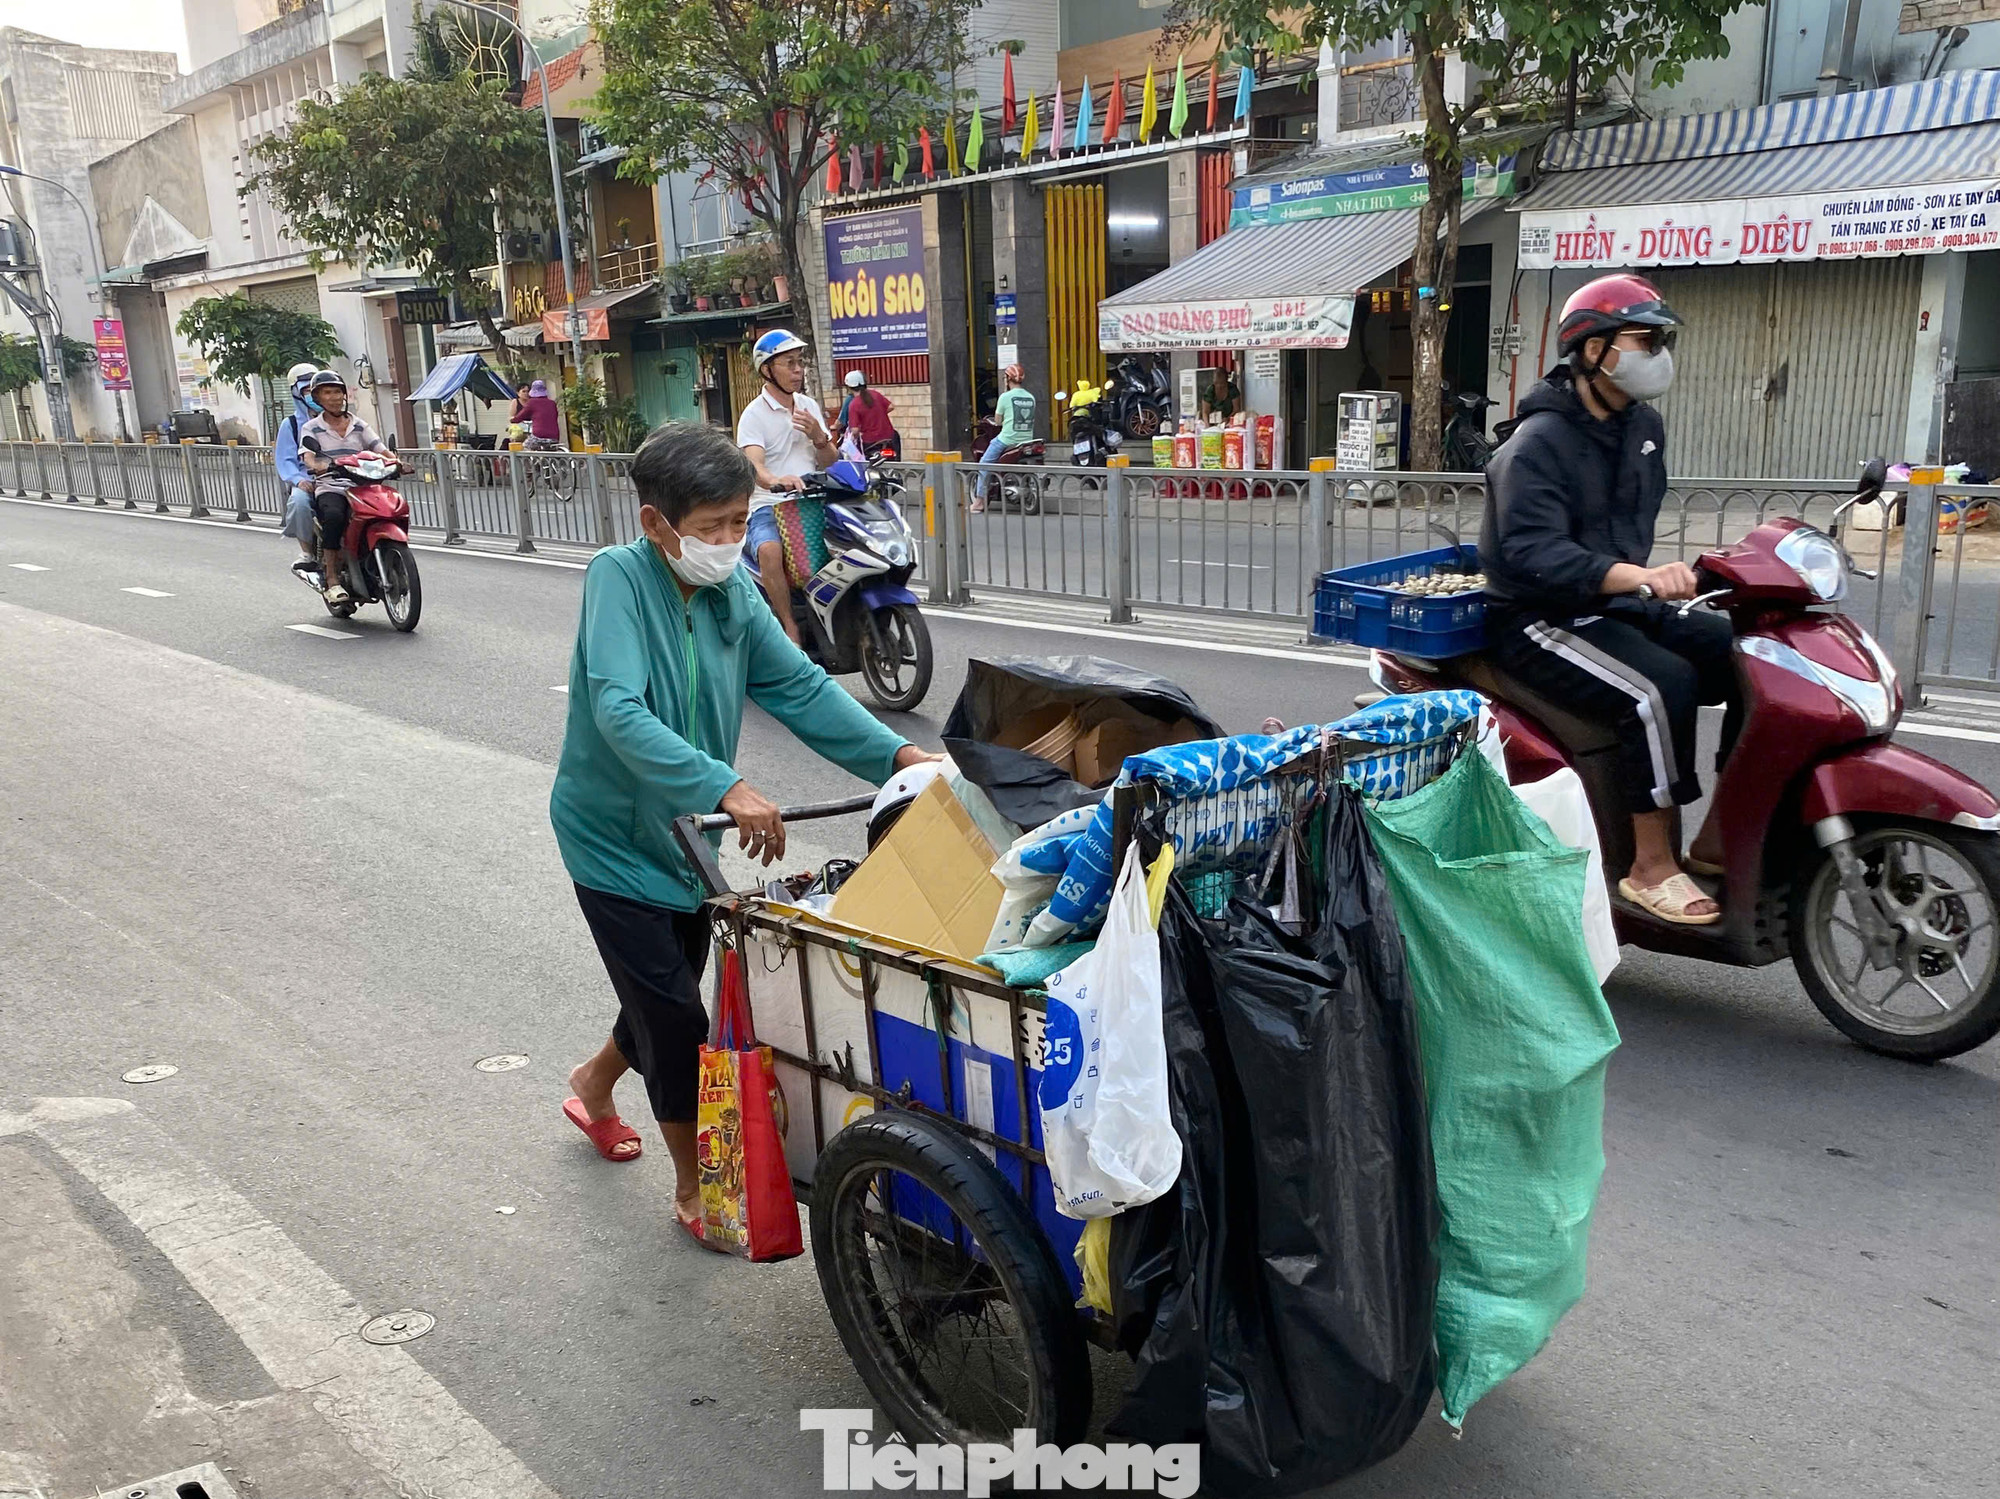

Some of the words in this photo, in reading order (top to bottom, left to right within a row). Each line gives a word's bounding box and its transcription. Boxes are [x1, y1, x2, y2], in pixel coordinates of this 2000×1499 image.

[1281, 178, 1325, 196] Salonpas
[1370, 194, 1395, 209] HUY
[1823, 199, 1860, 216] CHUYÊN
[1863, 197, 1883, 214] LÀM
[1924, 195, 1945, 209] SƠN
[1948, 194, 1962, 207] XE
[1965, 191, 1984, 205] TAY
[1986, 188, 2000, 204] GA
[1854, 220, 1886, 236] TRANG
[1889, 220, 1904, 234] XE
[1906, 214, 1922, 232] SỐ
[1931, 216, 1946, 230] XE
[1950, 214, 1968, 228] TAY
[1970, 213, 1986, 226] GA
[1554, 213, 1616, 262] HIỀN
[829, 268, 877, 320] NGÔI
[884, 272, 925, 316] SAO
[402, 301, 444, 322] CHAY
[1158, 305, 1214, 334] HOÀNG
[1218, 302, 1253, 332] PHÚ
